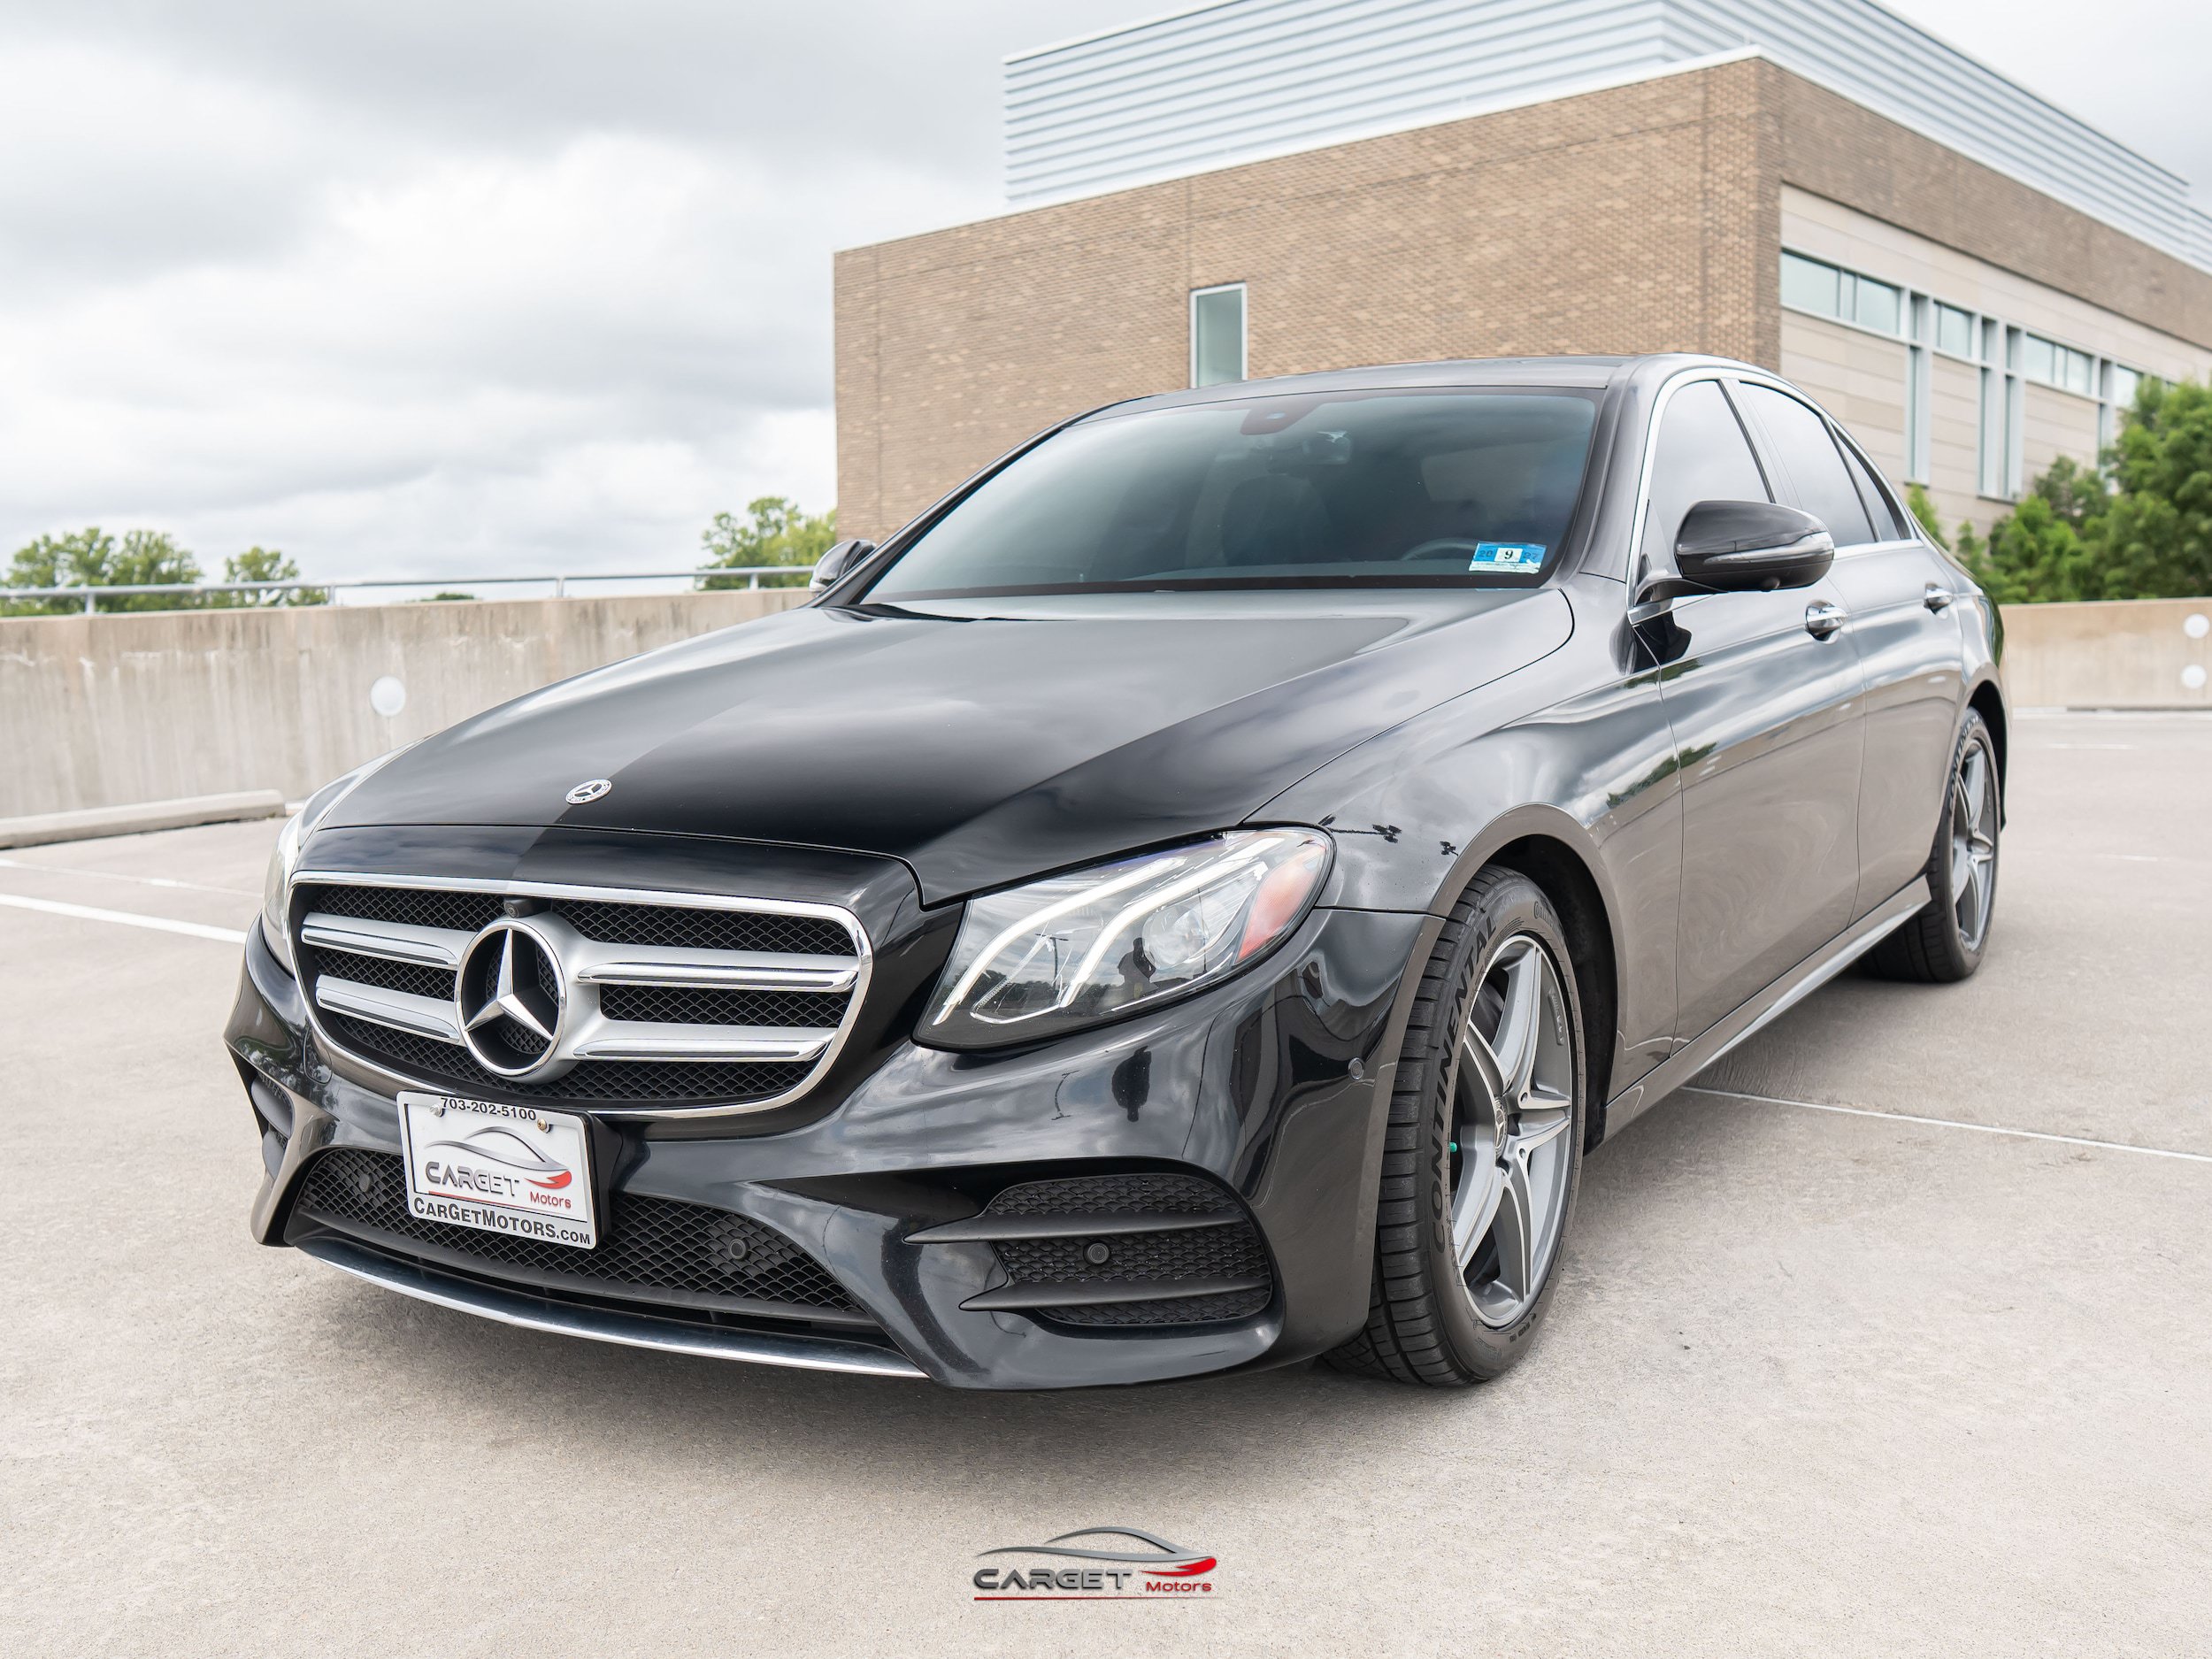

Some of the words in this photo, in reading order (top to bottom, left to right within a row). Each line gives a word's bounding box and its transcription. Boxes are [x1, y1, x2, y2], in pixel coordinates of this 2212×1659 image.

[1504, 549, 1514, 559] 9
[1432, 916, 1497, 1253] CONTINENTAL
[441, 1097, 536, 1121] 703-202-5100
[425, 1161, 520, 1196] CARGET
[530, 1191, 572, 1209] Motors
